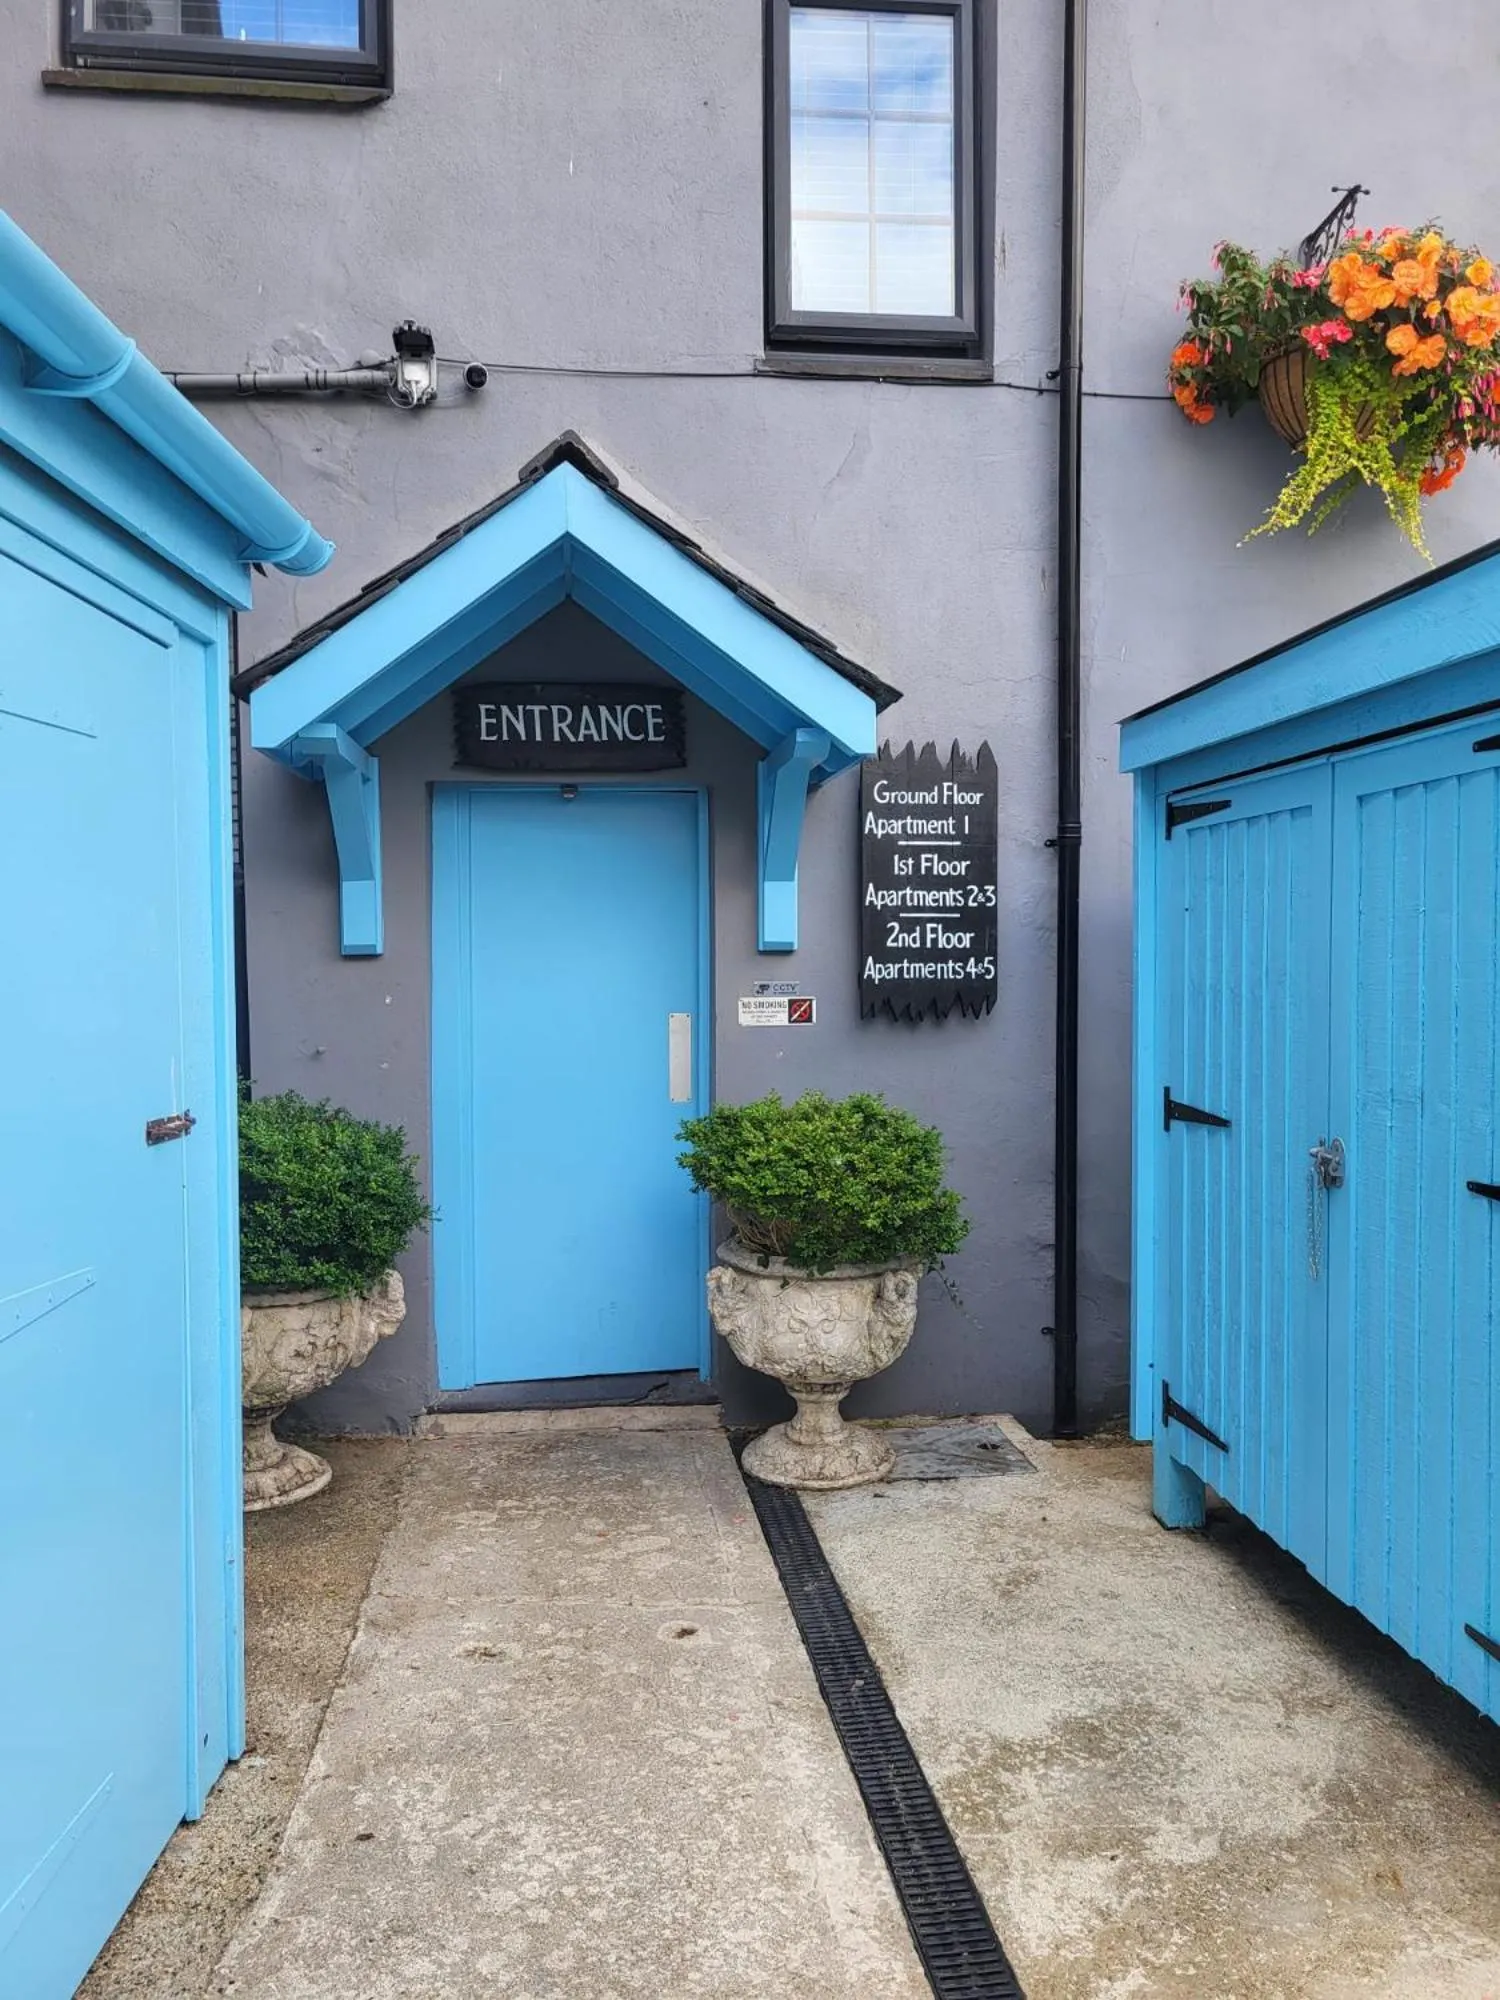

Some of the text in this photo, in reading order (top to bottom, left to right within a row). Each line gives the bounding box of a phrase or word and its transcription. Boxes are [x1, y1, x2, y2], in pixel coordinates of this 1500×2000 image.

[478, 703, 666, 742] ENTRANCE
[873, 779, 984, 805] Ground Floor
[864, 810, 956, 839] Apartment
[893, 853, 971, 876] 1st Floor
[865, 882, 996, 911] Apartments 2&3
[886, 921, 975, 949] 2nd Floor
[863, 955, 995, 985] Apartments 4&5
[742, 1000, 787, 1009] NO SMOKING
